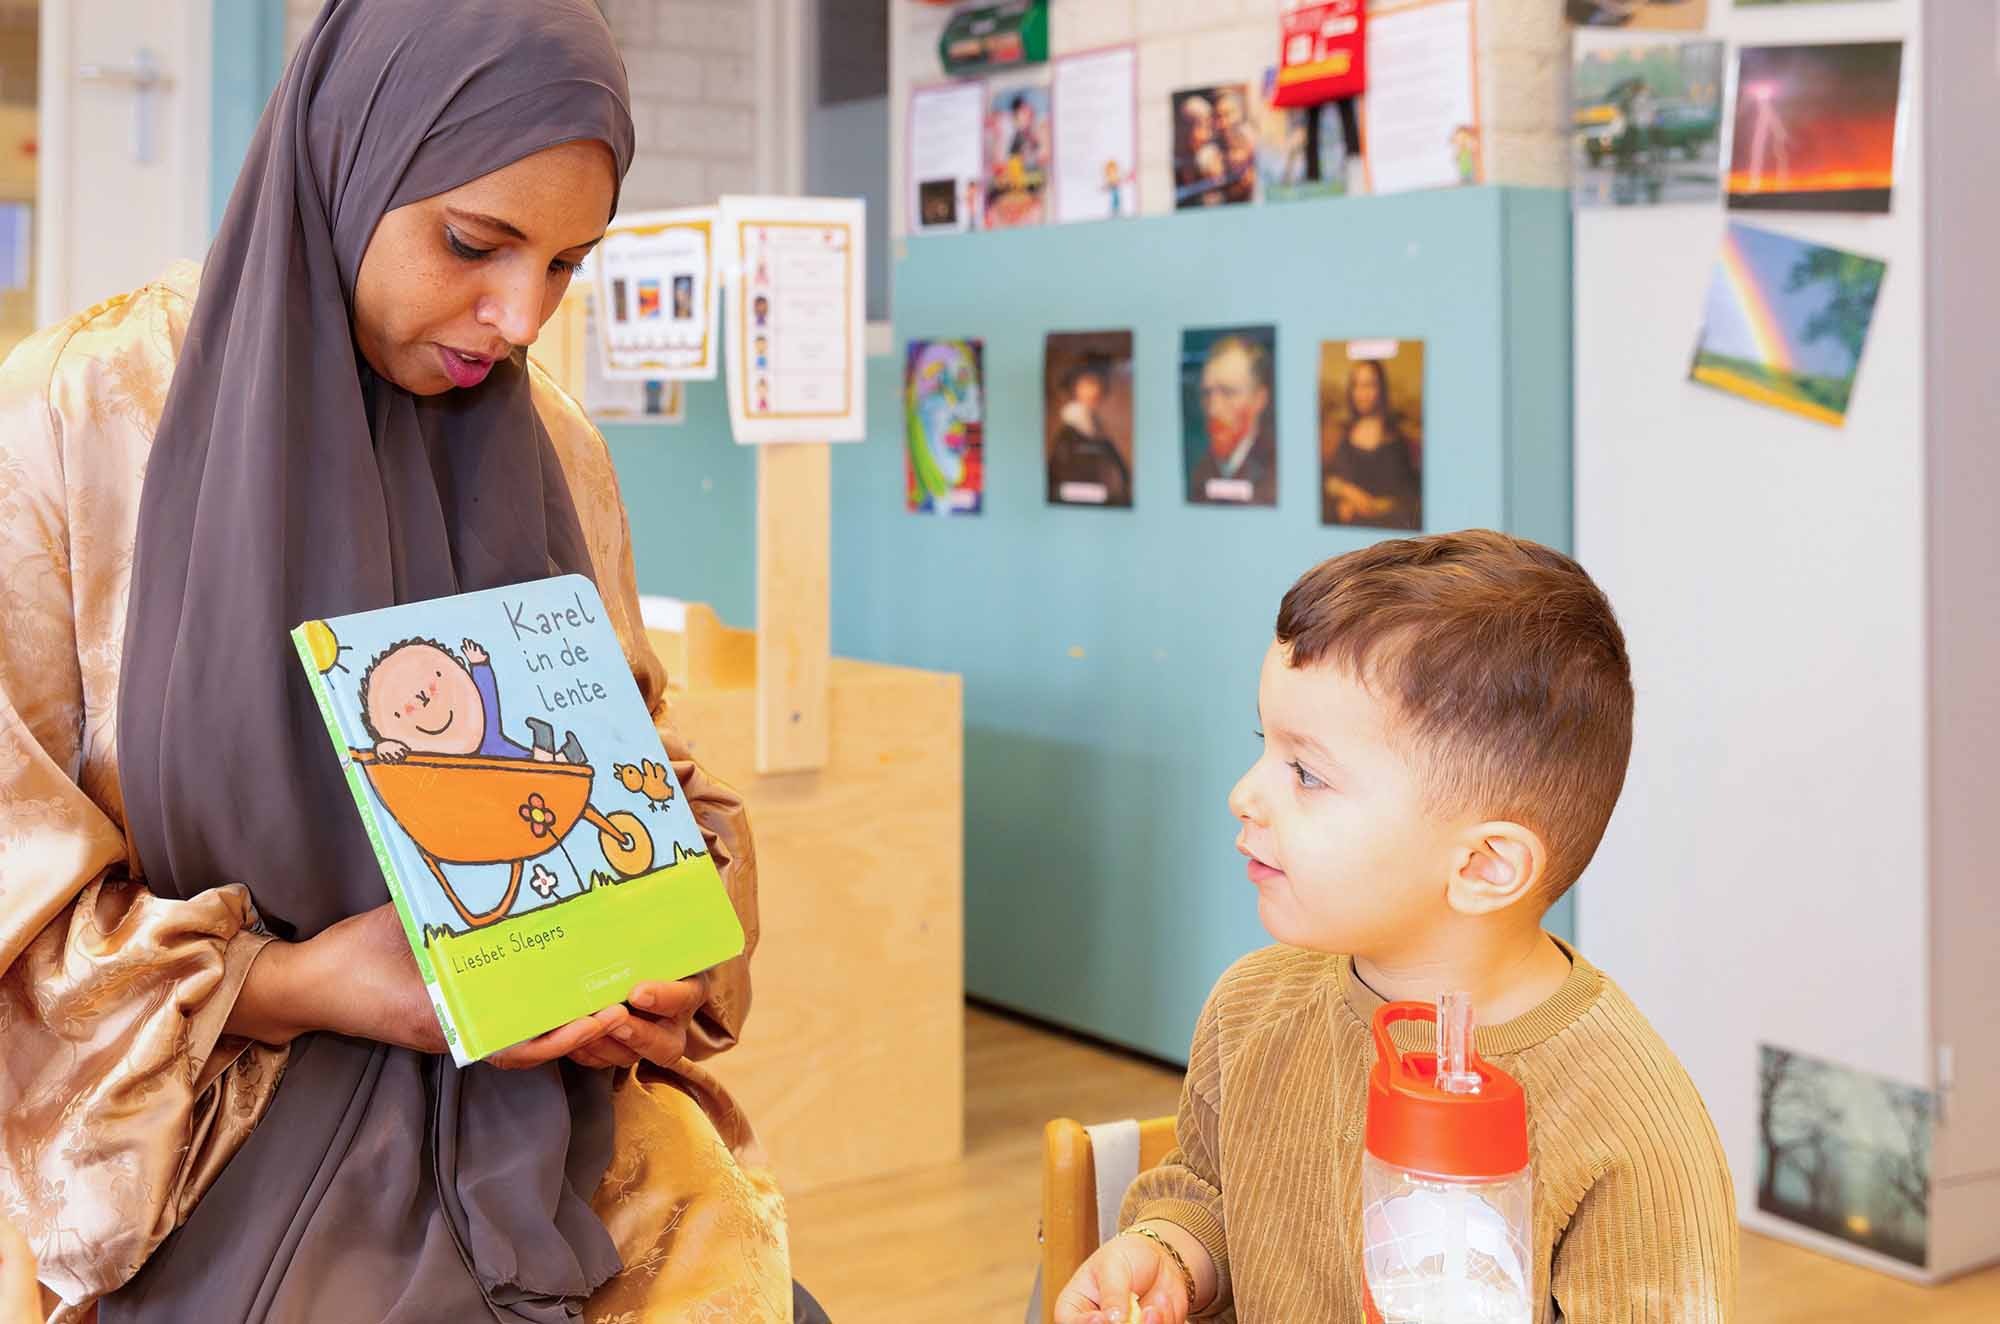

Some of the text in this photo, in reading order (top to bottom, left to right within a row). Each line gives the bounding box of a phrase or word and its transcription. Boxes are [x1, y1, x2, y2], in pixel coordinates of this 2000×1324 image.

[502, 591, 596, 641] Karel
[523, 636, 590, 673] in de
[536, 678, 608, 713] lente
[451, 924, 566, 975] Liesbet Slegers
